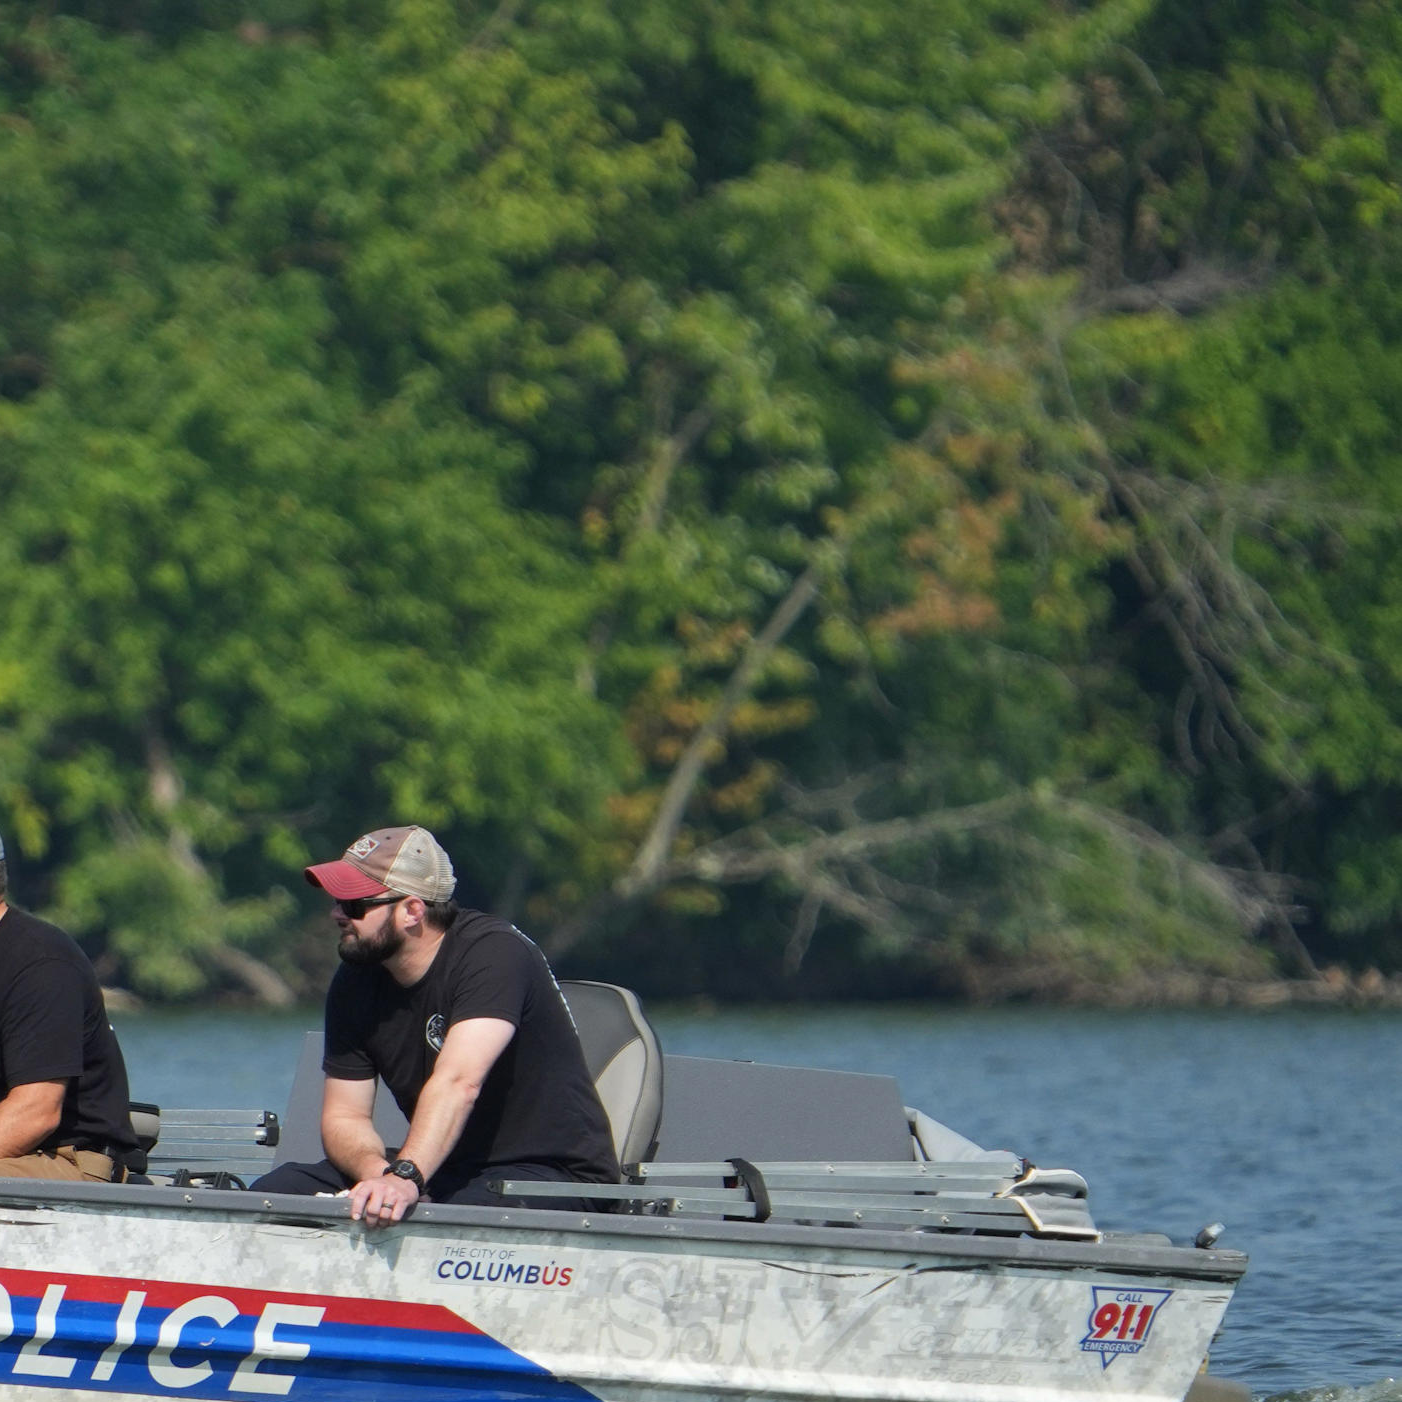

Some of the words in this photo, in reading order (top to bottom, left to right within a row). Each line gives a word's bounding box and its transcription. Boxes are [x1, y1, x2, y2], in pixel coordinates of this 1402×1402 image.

[444, 1247, 466, 1257] THE
[469, 1248, 497, 1258] CITY
[498, 1250, 516, 1260] OF
[437, 1259, 573, 1286] COLUMBUS
[1115, 1293, 1144, 1303] CALL
[1084, 1342, 1138, 1352] EMERGENCY
